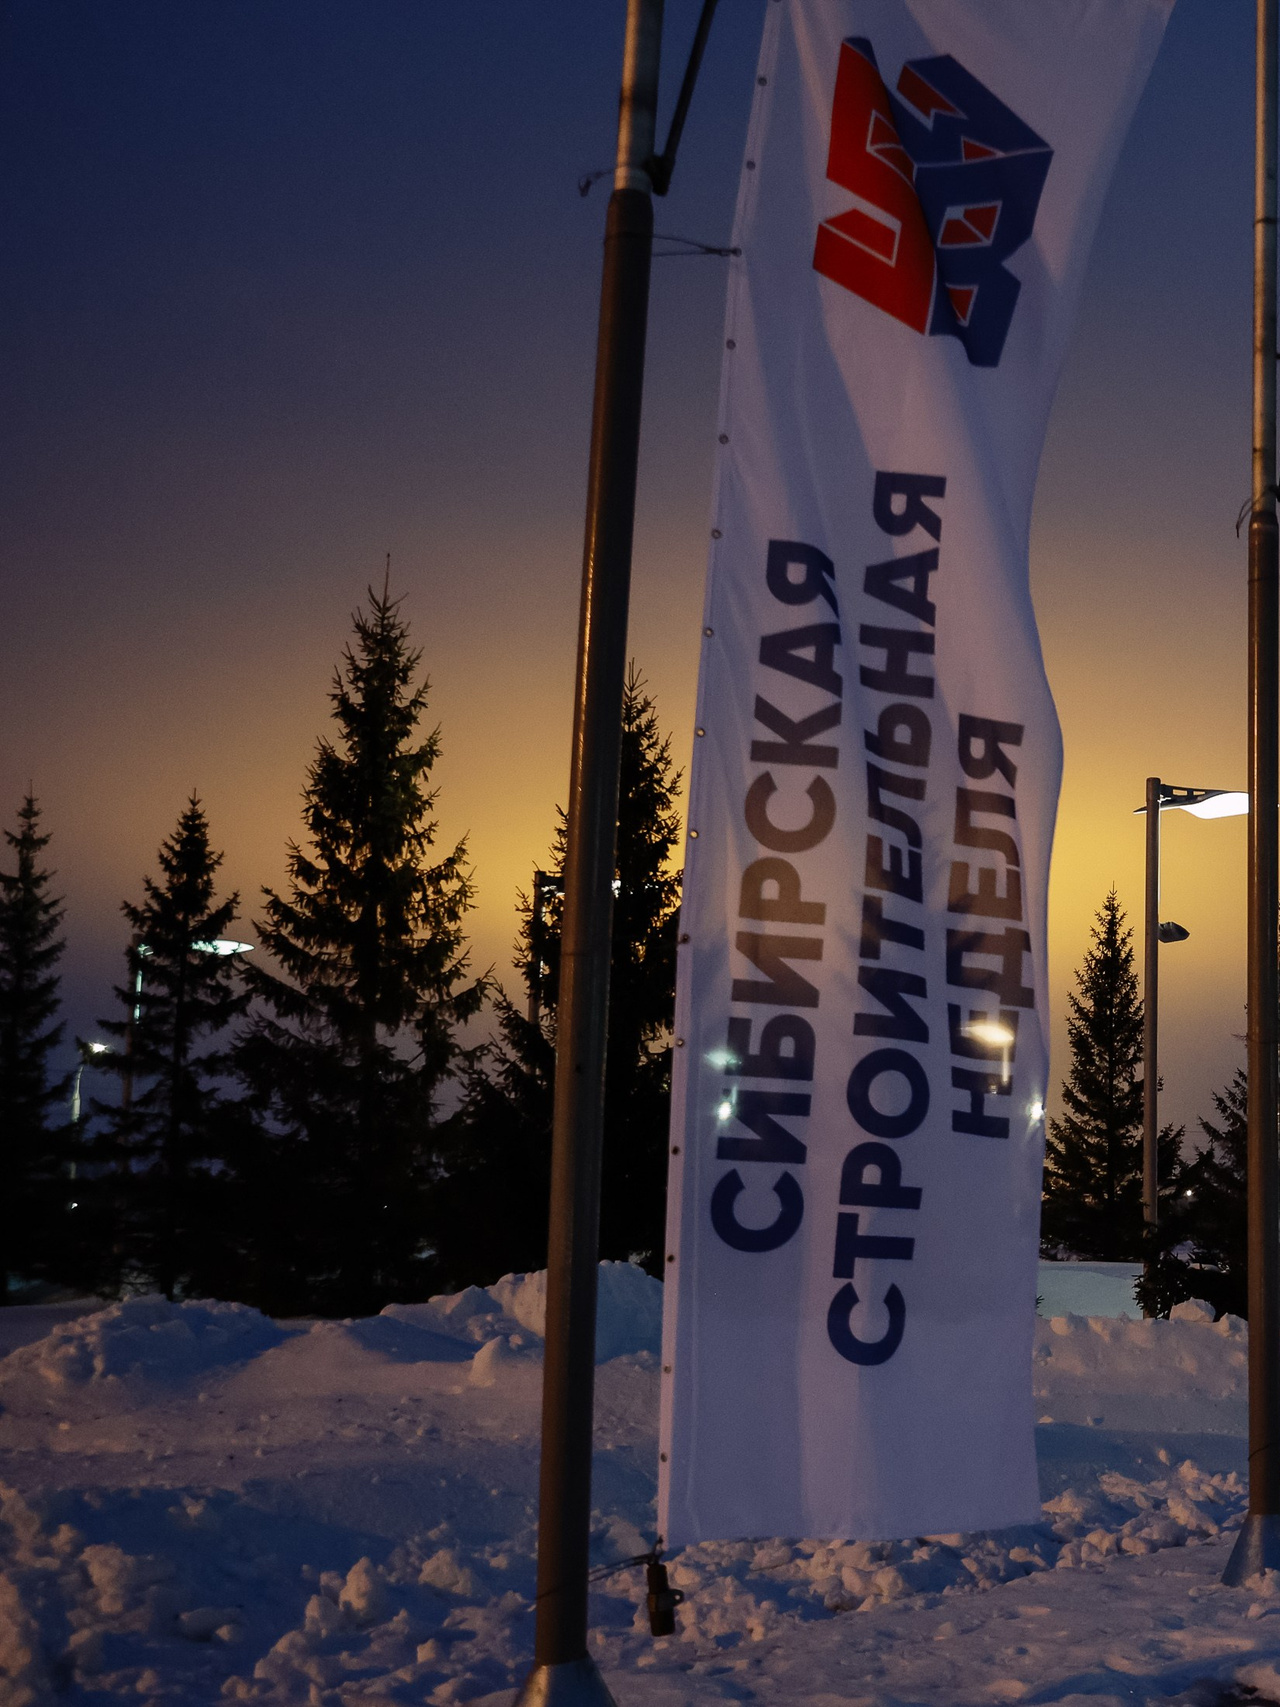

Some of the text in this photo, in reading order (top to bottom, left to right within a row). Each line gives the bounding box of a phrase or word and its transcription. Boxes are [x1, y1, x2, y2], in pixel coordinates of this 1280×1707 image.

[710, 538, 843, 1253] СИБИРСКАЯ
[826, 470, 947, 1367] СТРОИТЕЛЬНАЯ
[945, 712, 1035, 1139] НЕДЕЛЯ
